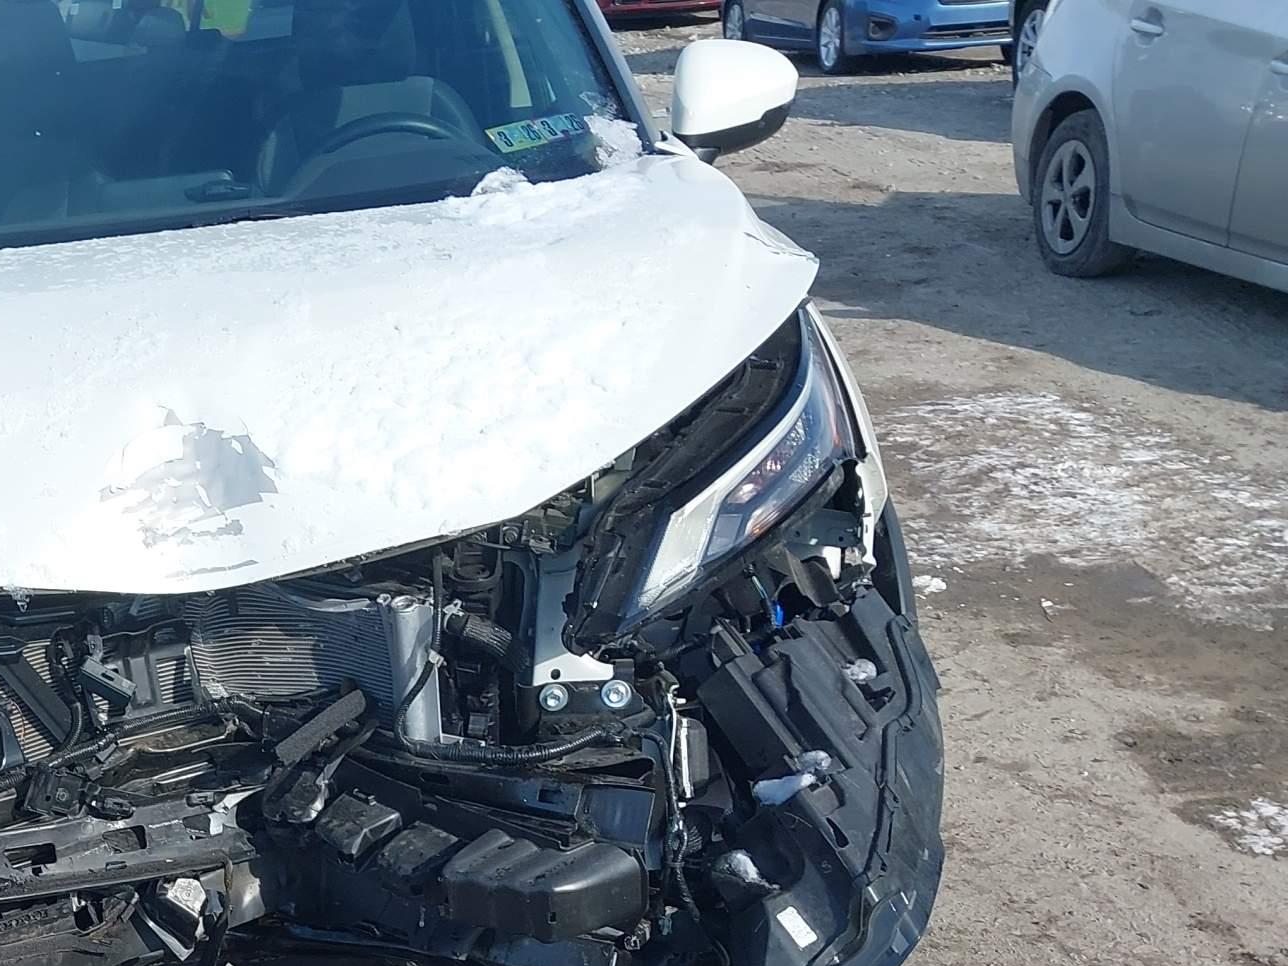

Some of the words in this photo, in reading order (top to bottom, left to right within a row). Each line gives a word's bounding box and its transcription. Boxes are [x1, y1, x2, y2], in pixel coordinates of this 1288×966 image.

[497, 130, 514, 147] 3
[520, 123, 542, 141] 26
[540, 120, 558, 137] 3
[564, 114, 585, 131] 26
